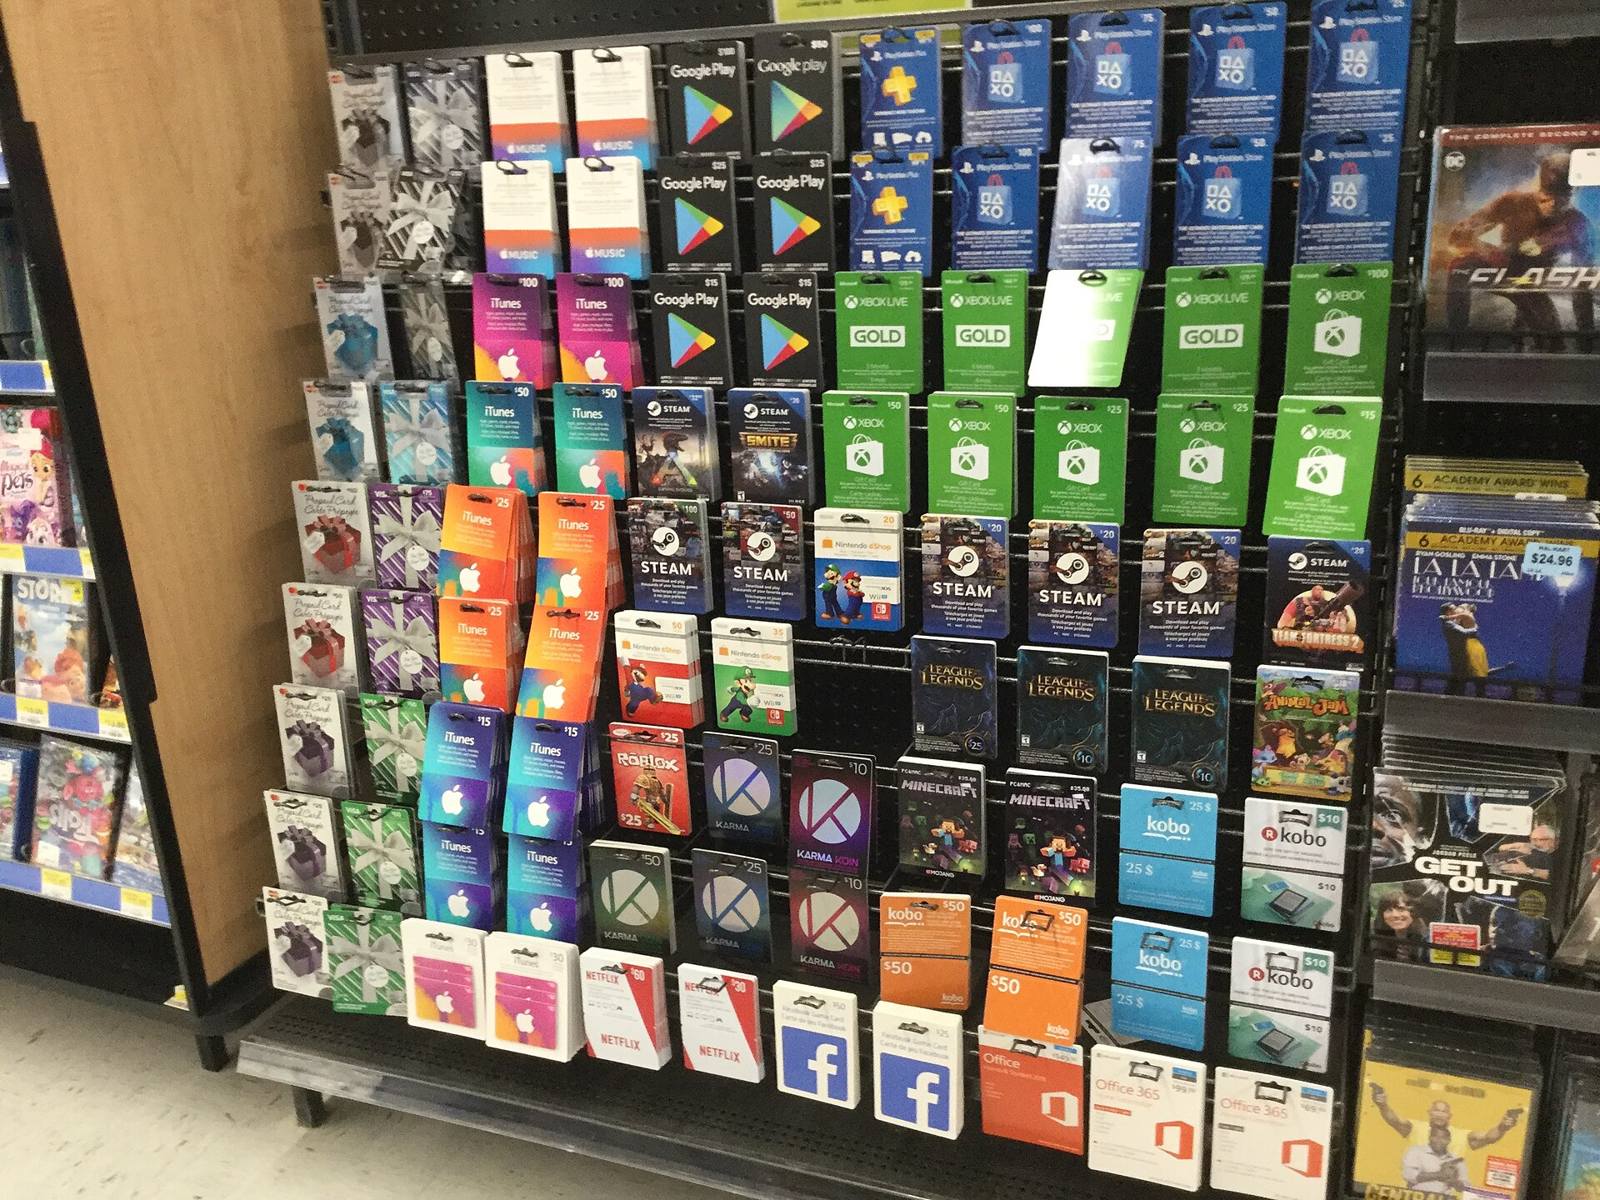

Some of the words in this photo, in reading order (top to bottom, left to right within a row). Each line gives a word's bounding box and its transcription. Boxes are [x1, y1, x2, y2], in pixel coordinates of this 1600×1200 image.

[670, 64, 712, 80] Google
[712, 63, 736, 78] Play
[1474, 132, 1534, 140] COMPLETE
[1539, 130, 1588, 138] SECOND
[516, 144, 547, 153] MUSIC
[661, 177, 702, 192] Google
[702, 176, 728, 192] Play
[756, 176, 800, 192] Google
[800, 175, 826, 190] Play
[508, 250, 538, 260] MUSIC
[594, 248, 626, 258] MUSIC
[1368, 269, 1388, 279] $100
[518, 277, 538, 288] $100
[604, 277, 624, 288] $100
[704, 278, 718, 287] $15
[798, 278, 812, 287] $15
[654, 292, 694, 308] Google
[696, 292, 719, 308] Play
[747, 293, 788, 309] Google
[789, 293, 812, 309] Play
[859, 297, 887, 307] XBOX
[888, 297, 908, 307] LIVE
[964, 296, 992, 306] XBOX
[992, 296, 1013, 306] LIVE
[1192, 294, 1222, 304] XBOX
[1223, 292, 1248, 304] LIVE
[1334, 290, 1366, 301] XBOX
[490, 298, 522, 309] iTunes
[576, 298, 608, 310] iTunes
[854, 329, 902, 344] GOLD
[960, 328, 1006, 342] GOLD
[1184, 328, 1238, 344] GOLD
[514, 386, 529, 397] $50
[602, 388, 618, 398] $50
[484, 406, 514, 418] iTunes
[760, 408, 788, 416] STEAM
[888, 402, 901, 410] $50
[1108, 405, 1122, 414] $25
[1233, 403, 1248, 412] $25
[572, 408, 603, 420] iTunes
[1360, 410, 1376, 420] $15
[858, 418, 884, 428] XBOX
[964, 420, 991, 431] XBOX
[1074, 422, 1103, 433] XBOX
[1196, 421, 1227, 432] XBOX
[1318, 428, 1352, 440] XBOX
[746, 435, 790, 448] SMITE
[1412, 474, 1424, 488] 6
[1433, 474, 1491, 487] ACADEMY
[1493, 477, 1536, 488] AWARD
[1540, 478, 1570, 488] WINS
[462, 511, 492, 526] iTunes
[558, 518, 590, 531] iTunes
[988, 523, 1002, 532] $20
[1100, 530, 1114, 539] $20
[1221, 535, 1236, 544] $20
[1418, 534, 1430, 548] 6
[1440, 535, 1498, 546] ACADEMY
[835, 540, 868, 550] Nintendo
[868, 542, 892, 551] eShop
[1310, 558, 1348, 568] STEAM
[1531, 554, 1573, 567] $24.96
[641, 562, 692, 576] STEAM
[734, 566, 788, 582] STEAM
[932, 582, 992, 598] STEAM
[1039, 590, 1102, 606] STEAM
[1152, 600, 1220, 616] STEAM
[584, 610, 600, 621] $25
[458, 624, 488, 636] iTunes
[550, 628, 580, 640] iTunes
[730, 650, 760, 658] Nintendo
[930, 664, 973, 677] LEAGUE
[921, 672, 984, 690] LEGENDS
[1038, 674, 1086, 688] LEAGUE
[1028, 683, 1096, 702] LEGENDS
[1154, 688, 1204, 702] LEAGUE
[1144, 696, 1216, 717] LEGENDS
[478, 716, 491, 727] $15
[564, 726, 578, 737] $15
[660, 732, 678, 744] $25
[444, 732, 475, 746] iTunes
[530, 742, 562, 757] iTunes
[754, 742, 773, 756] $25
[617, 752, 680, 772] ROBLOX
[850, 762, 868, 776] $10
[900, 780, 978, 798] MINECRAFT
[1008, 794, 1090, 810] MINECRAFT
[1190, 801, 1202, 811] 25
[620, 813, 643, 827] $25
[1146, 815, 1190, 835] kobo
[1318, 813, 1340, 824] $10
[716, 820, 750, 833] KARMA
[1280, 827, 1327, 848] kobo
[641, 854, 661, 867] $50
[796, 850, 832, 864] KARMA
[744, 861, 762, 874] $25
[1126, 862, 1144, 874] 25
[1144, 864, 1154, 876] $
[1414, 856, 1483, 878] GET
[844, 876, 862, 890] $10
[1318, 882, 1337, 892] $10
[1450, 876, 1518, 896] OUT
[943, 900, 965, 912] $50
[888, 907, 922, 921] kobo
[604, 930, 639, 943] KARMA
[705, 936, 740, 949] KARMA
[1178, 938, 1194, 948] 25
[1138, 950, 1182, 971] kobo
[1304, 957, 1327, 968] $10
[884, 961, 912, 975] $50
[586, 970, 620, 985] NETFLIX
[1268, 968, 1314, 990] kobo
[991, 975, 1020, 994] $50
[942, 992, 964, 1003] kobo
[1117, 994, 1134, 1006] 25
[1046, 1023, 1070, 1036] kobo
[1304, 1024, 1323, 1033] $10
[601, 1034, 640, 1051] NETFLIX
[700, 1045, 740, 1063] NETFLIX
[983, 1052, 1021, 1070] Office
[1096, 1079, 1134, 1096] Office
[1136, 1086, 1160, 1101] 365
[1220, 1098, 1261, 1114] Office
[1264, 1105, 1288, 1120] 365
